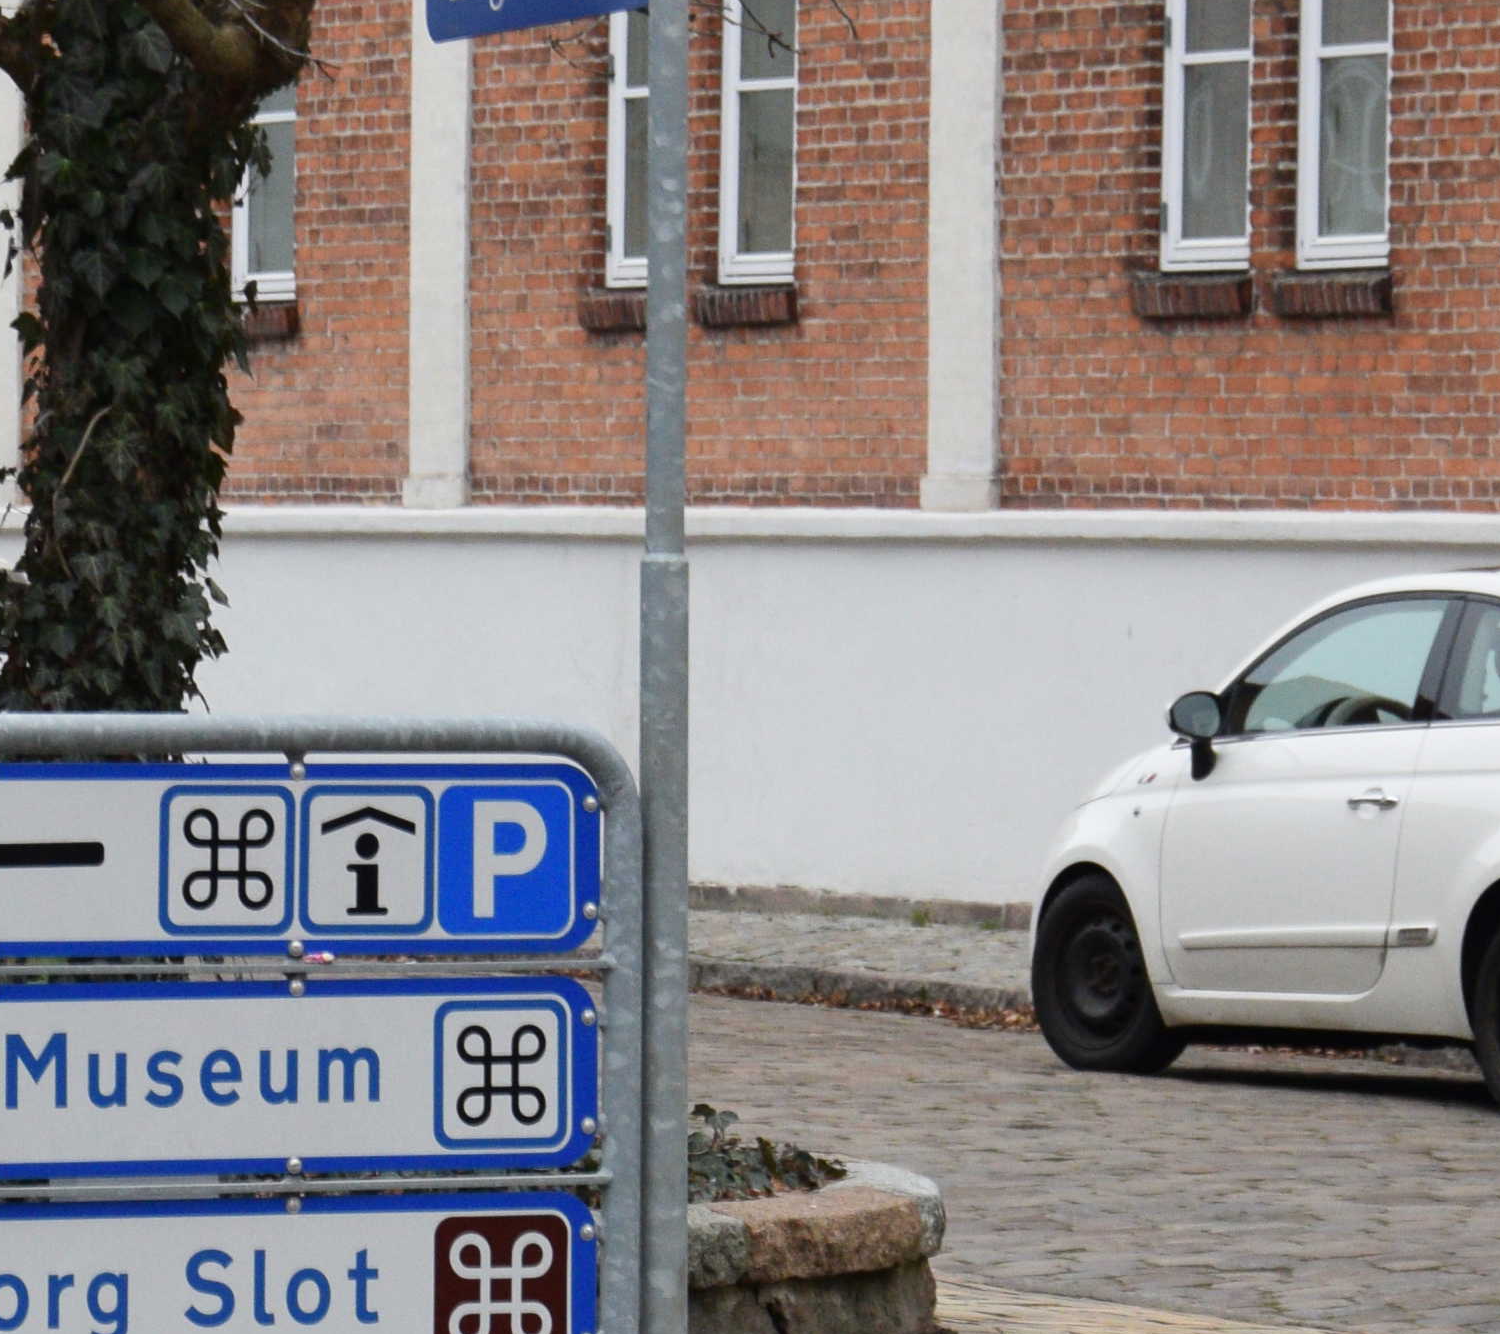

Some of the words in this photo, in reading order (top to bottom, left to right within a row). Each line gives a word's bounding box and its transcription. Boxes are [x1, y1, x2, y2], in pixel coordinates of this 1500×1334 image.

[473, 800, 548, 918] P
[4, 1032, 381, 1110] Museum
[185, 1249, 379, 1327] Slot
